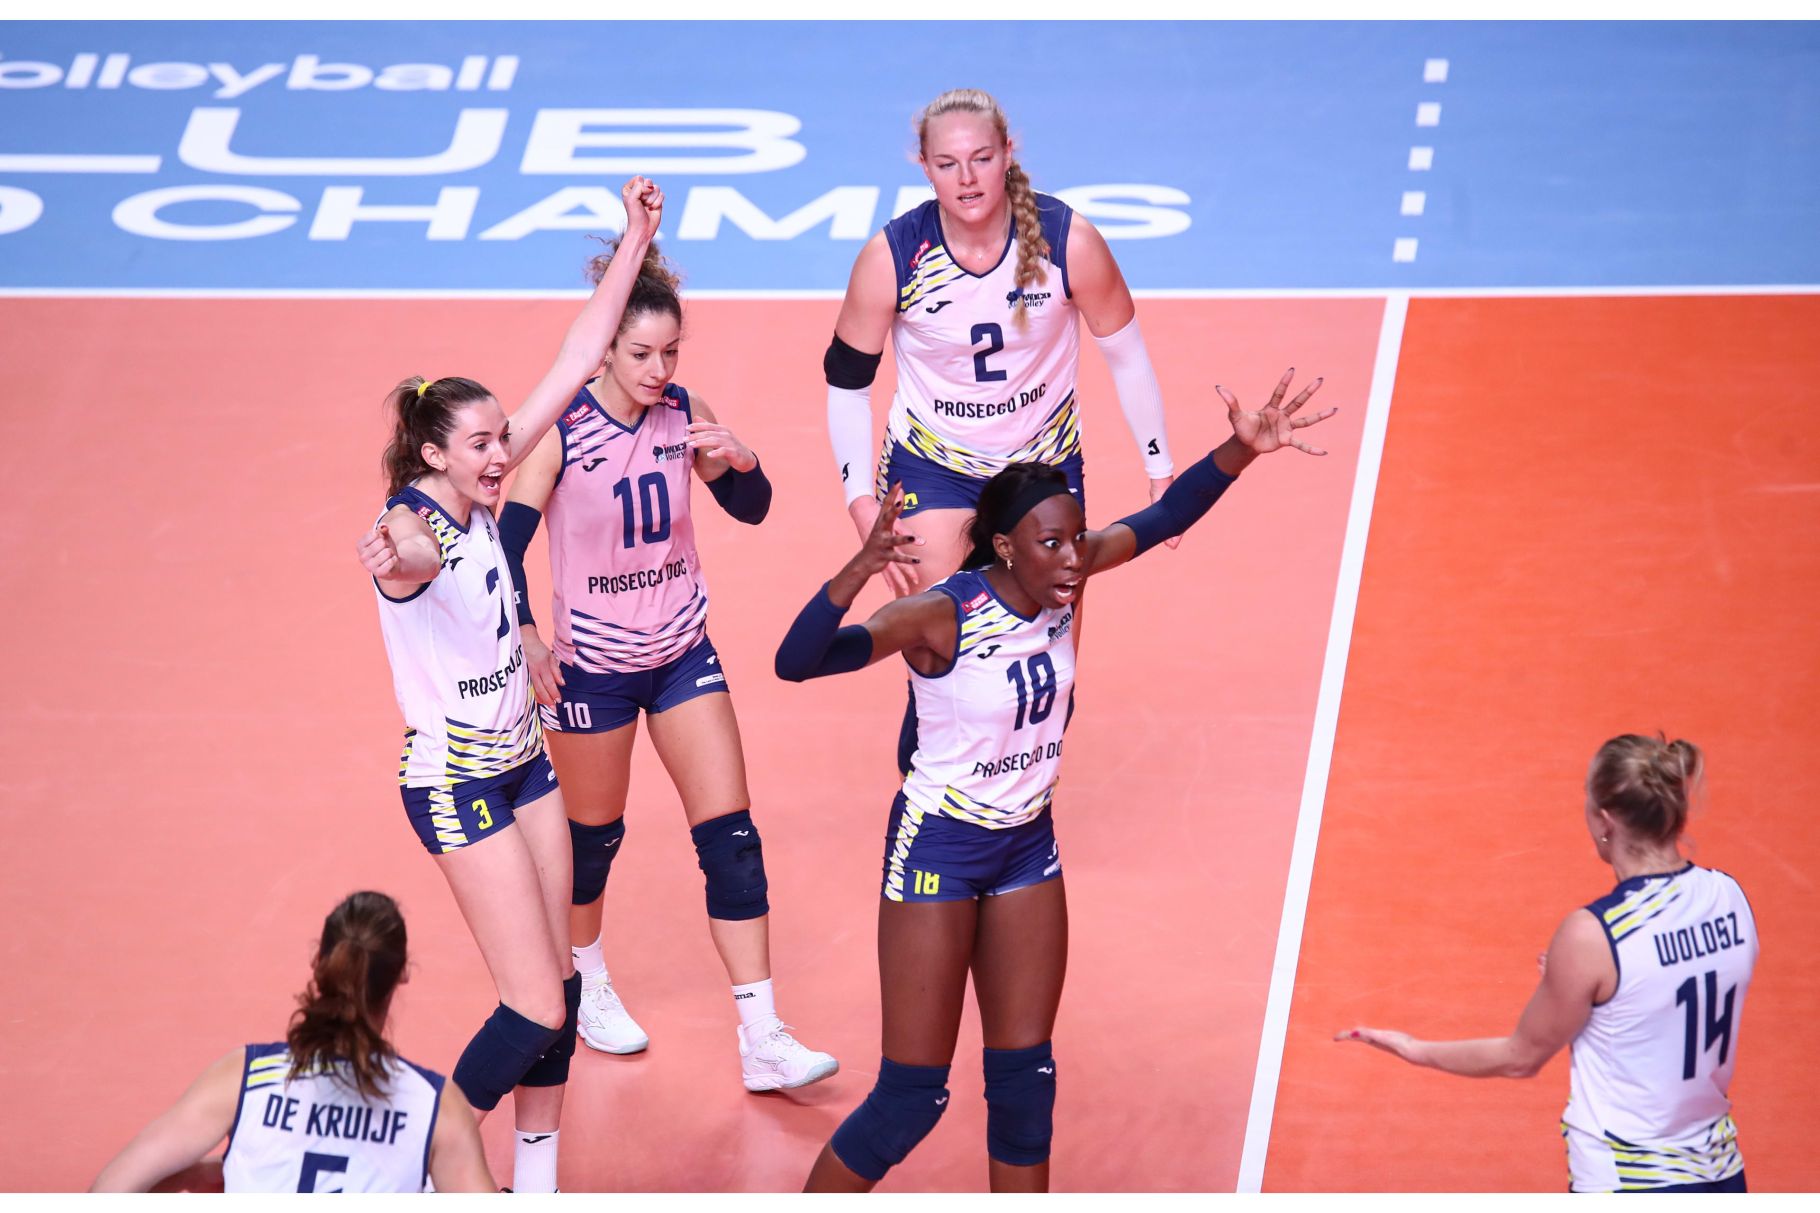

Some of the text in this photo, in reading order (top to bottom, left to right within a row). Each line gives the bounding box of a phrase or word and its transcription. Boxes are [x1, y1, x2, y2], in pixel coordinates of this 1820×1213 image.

[0, 54, 518, 98] olleyball
[112, 185, 1192, 240] CHAMS
[1024, 299, 1044, 308] olley
[970, 322, 1007, 382] 2
[934, 383, 1046, 418] PROSECCO DOC
[613, 471, 671, 549] 10
[588, 558, 687, 594] PROSECCO DOC
[1006, 651, 1057, 731] 18
[564, 701, 592, 729] 10
[1046, 740, 1063, 759] DO
[472, 799, 494, 830] 3
[912, 869, 940, 894] 18
[1654, 912, 1745, 967] WOLOSZ
[1676, 970, 1737, 1081] 14
[262, 1094, 408, 1145] DE KRUIJF
